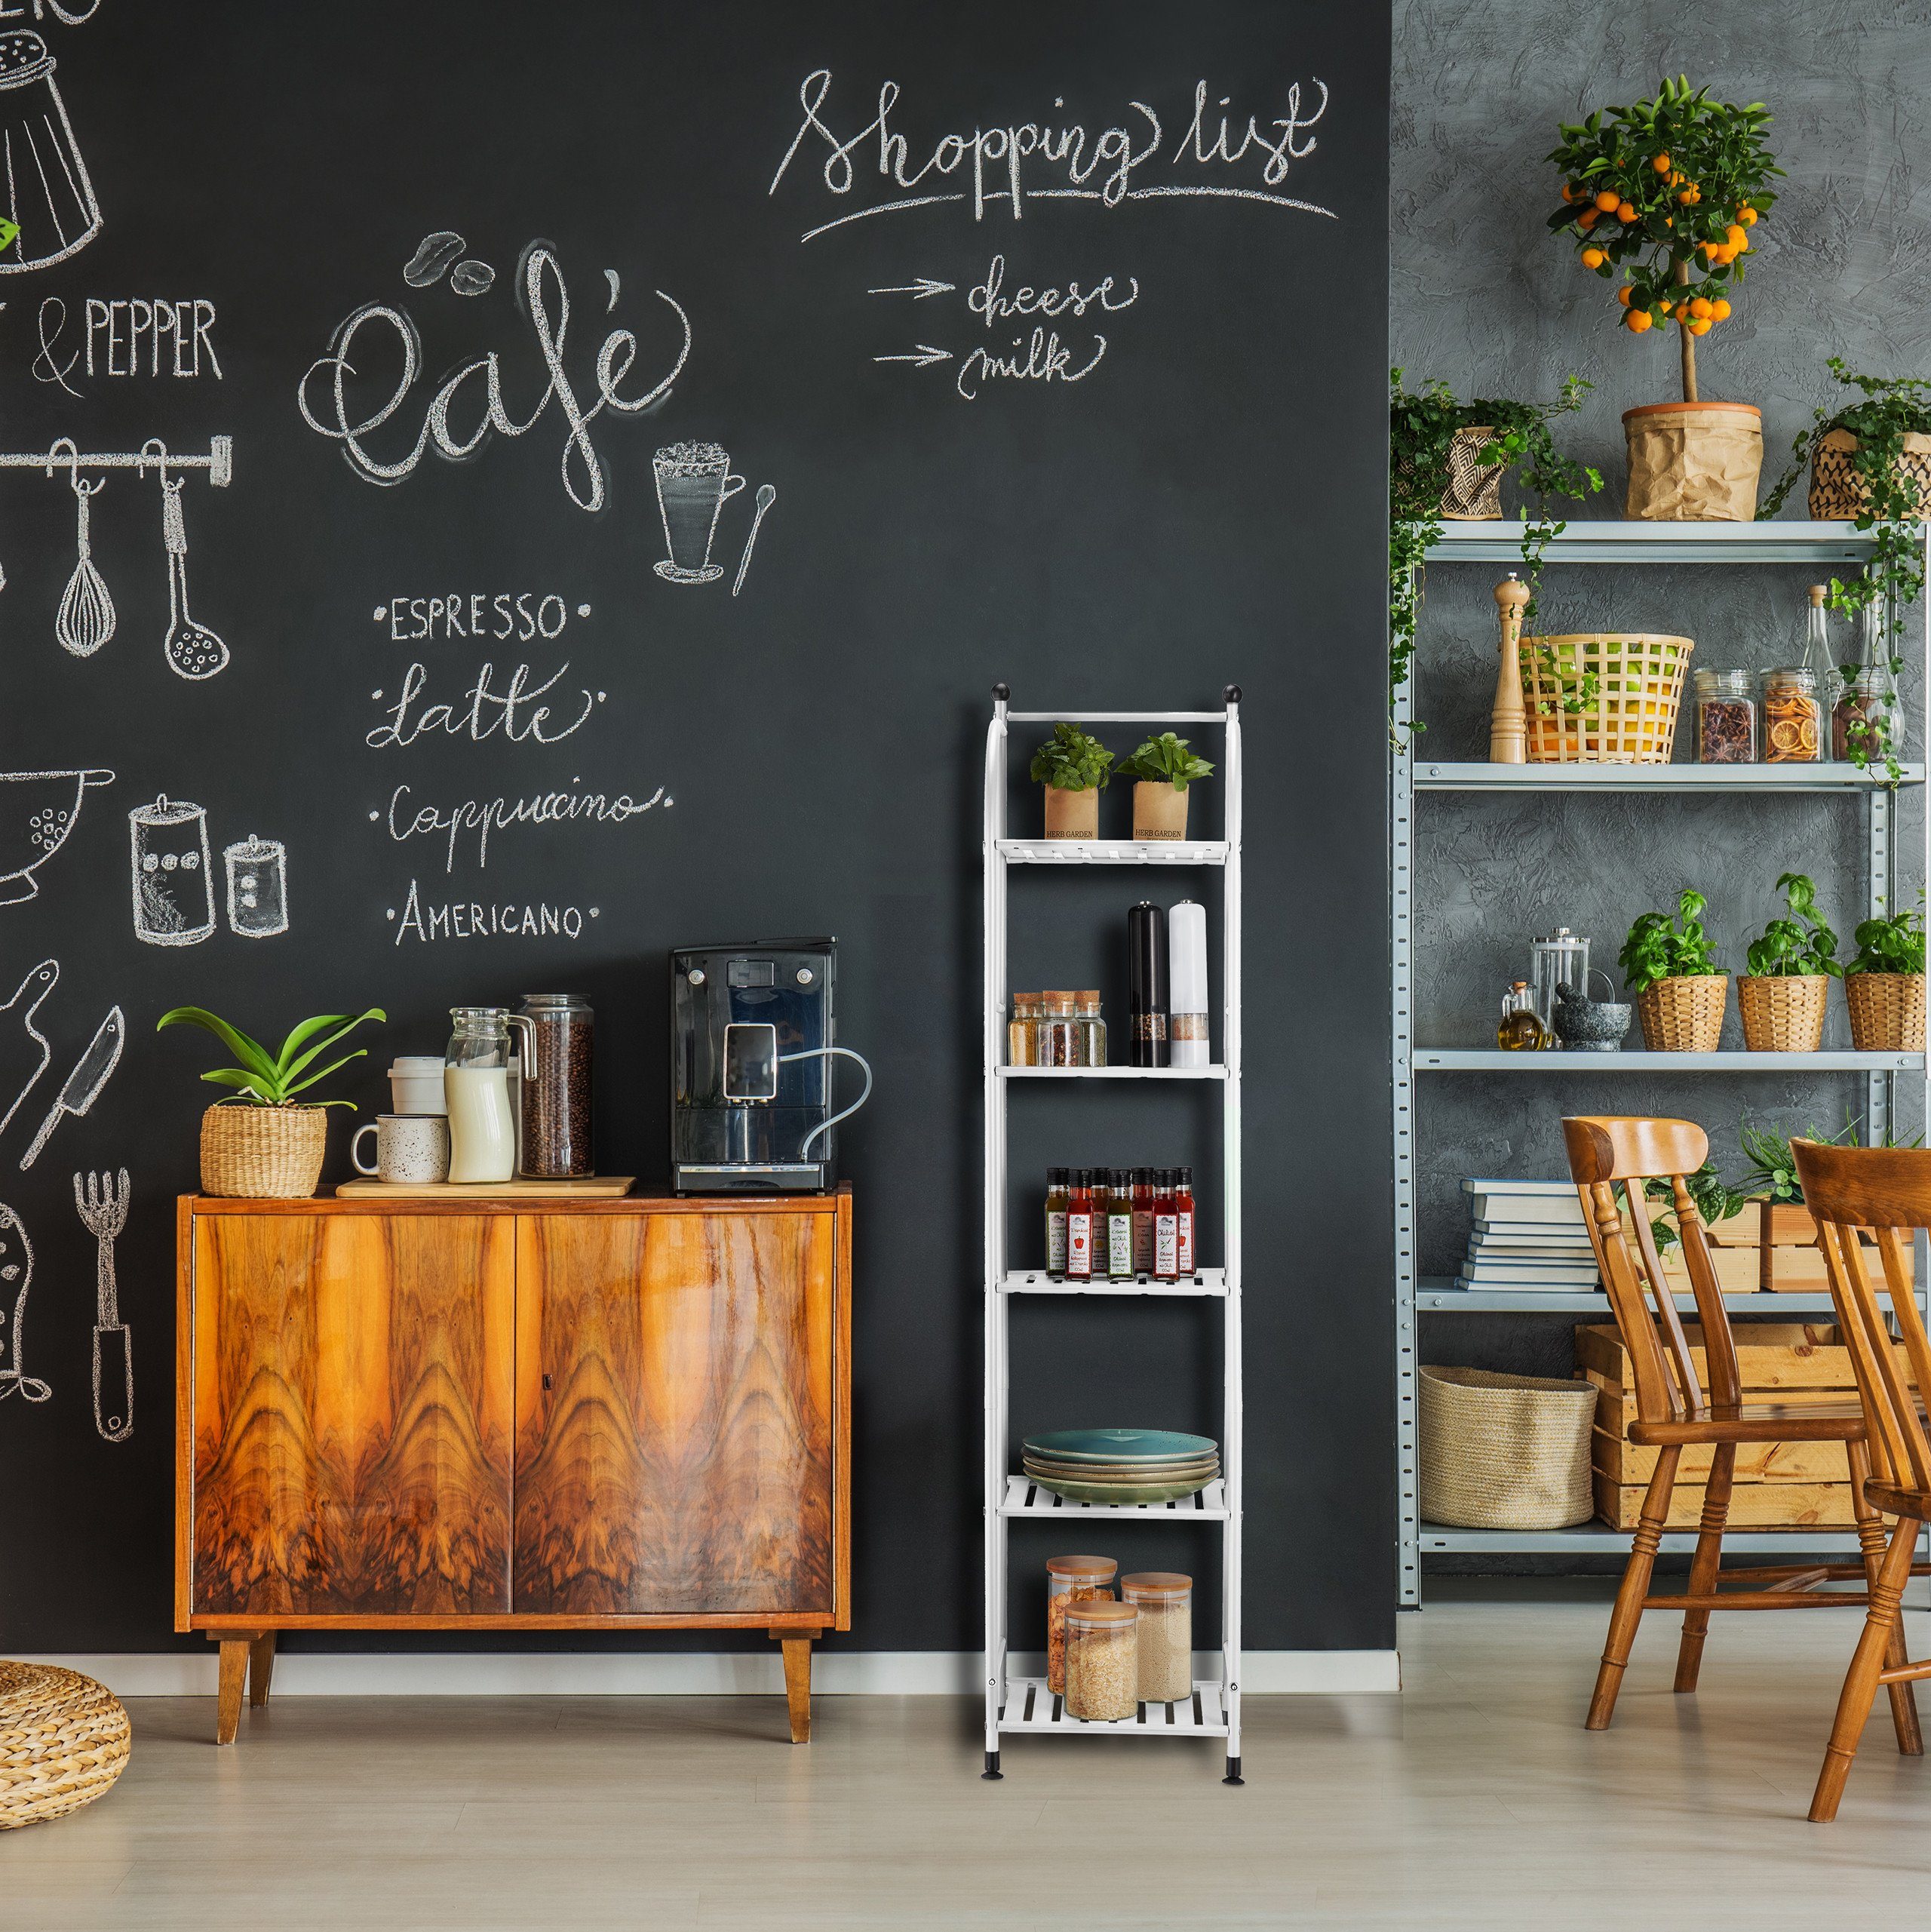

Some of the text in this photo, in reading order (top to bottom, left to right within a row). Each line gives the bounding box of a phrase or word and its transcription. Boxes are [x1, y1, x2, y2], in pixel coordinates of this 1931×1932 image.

[769, 69, 1328, 221] Shopping list
[968, 255, 1138, 327] cheese
[32, 296, 223, 398] & PEPPER
[298, 249, 692, 511] Café
[958, 326, 1107, 400] milk
[391, 593, 567, 641] ESPRESSO
[366, 660, 593, 748] Latte
[388, 776, 665, 874] Cappuccino
